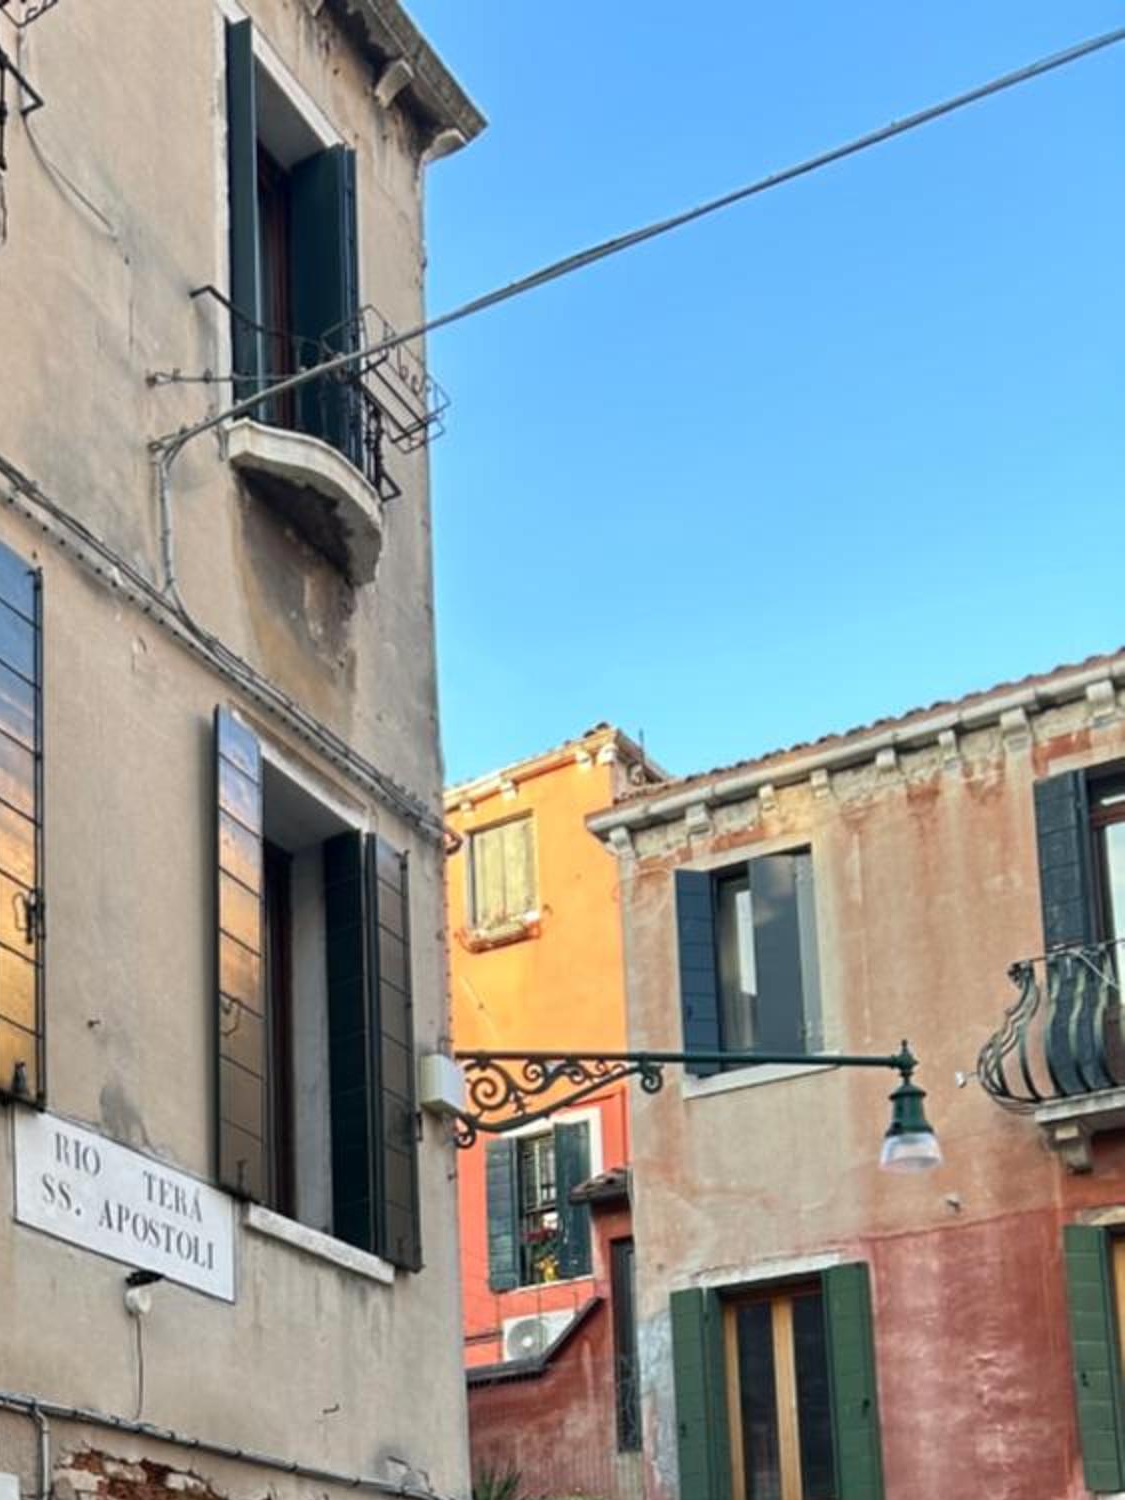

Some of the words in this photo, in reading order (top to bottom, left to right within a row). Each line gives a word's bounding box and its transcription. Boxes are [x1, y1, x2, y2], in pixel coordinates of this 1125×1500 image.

[55, 1132, 102, 1177] RIO
[41, 1172, 82, 1217] SS.
[99, 1199, 215, 1270] APOSTOLI
